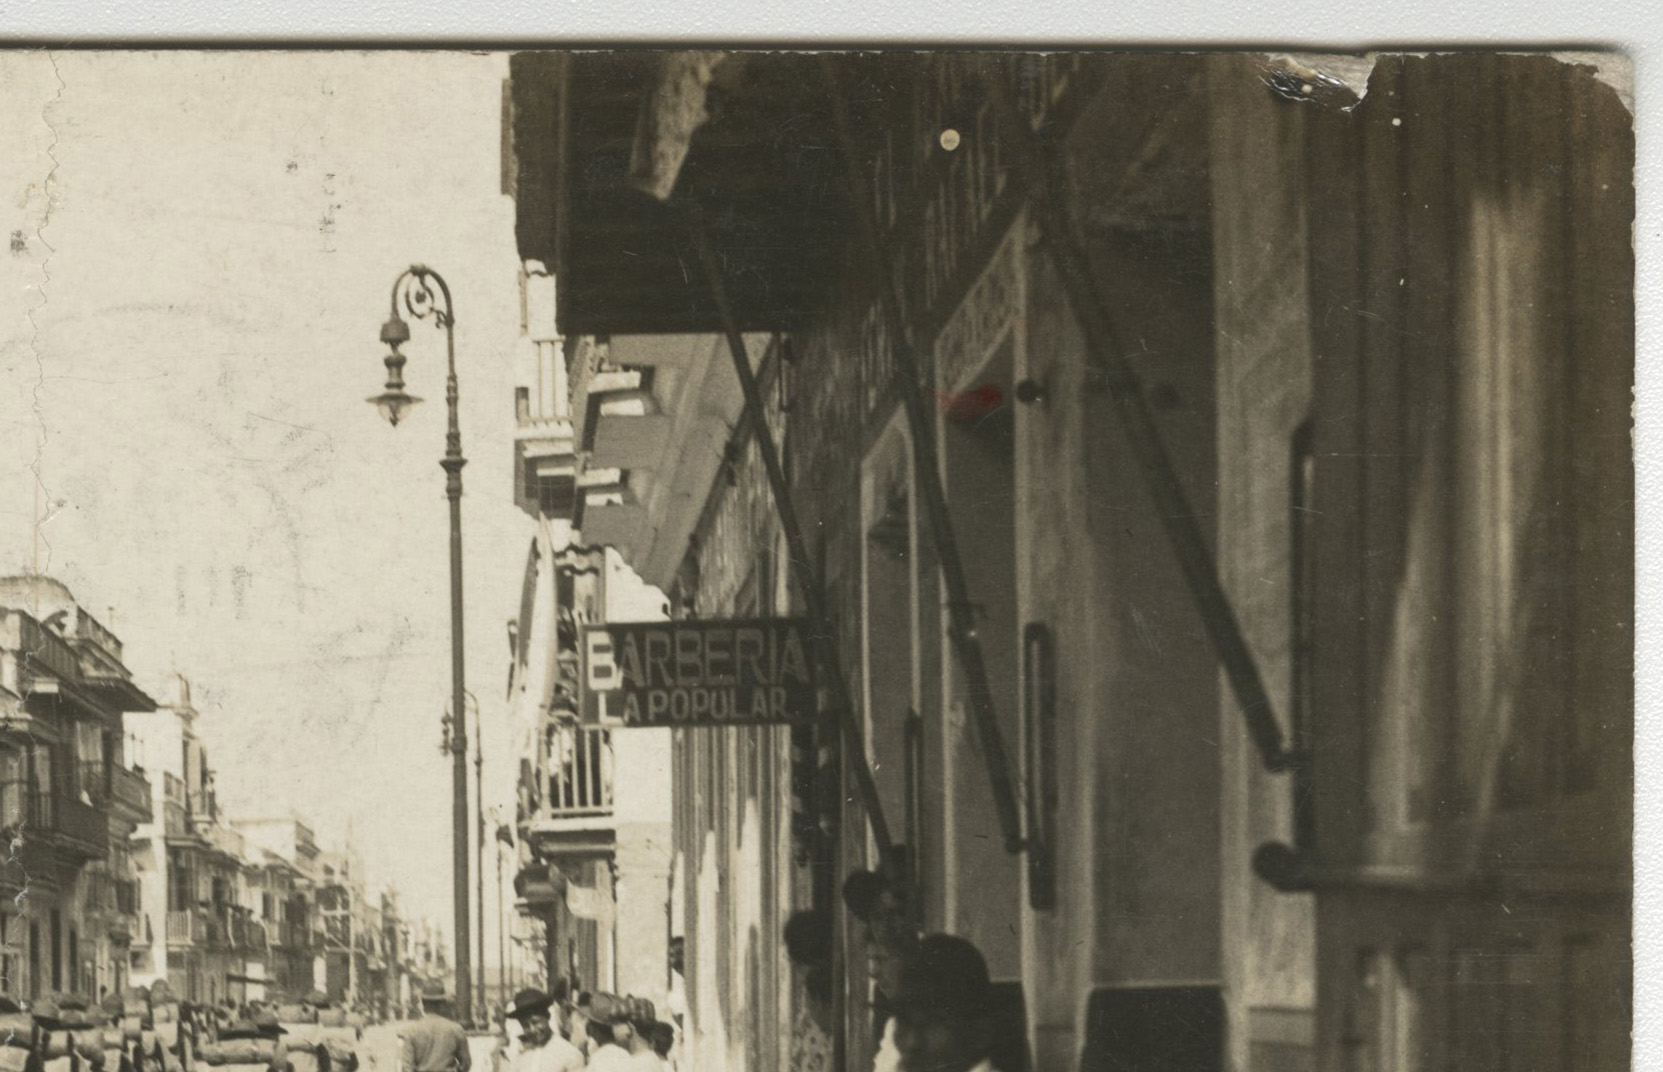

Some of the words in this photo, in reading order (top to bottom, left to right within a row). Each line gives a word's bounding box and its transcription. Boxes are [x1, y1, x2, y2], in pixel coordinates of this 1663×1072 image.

[587, 627, 810, 690] BARBERIA
[598, 690, 641, 725] LA
[648, 686, 791, 722] POPULAR
